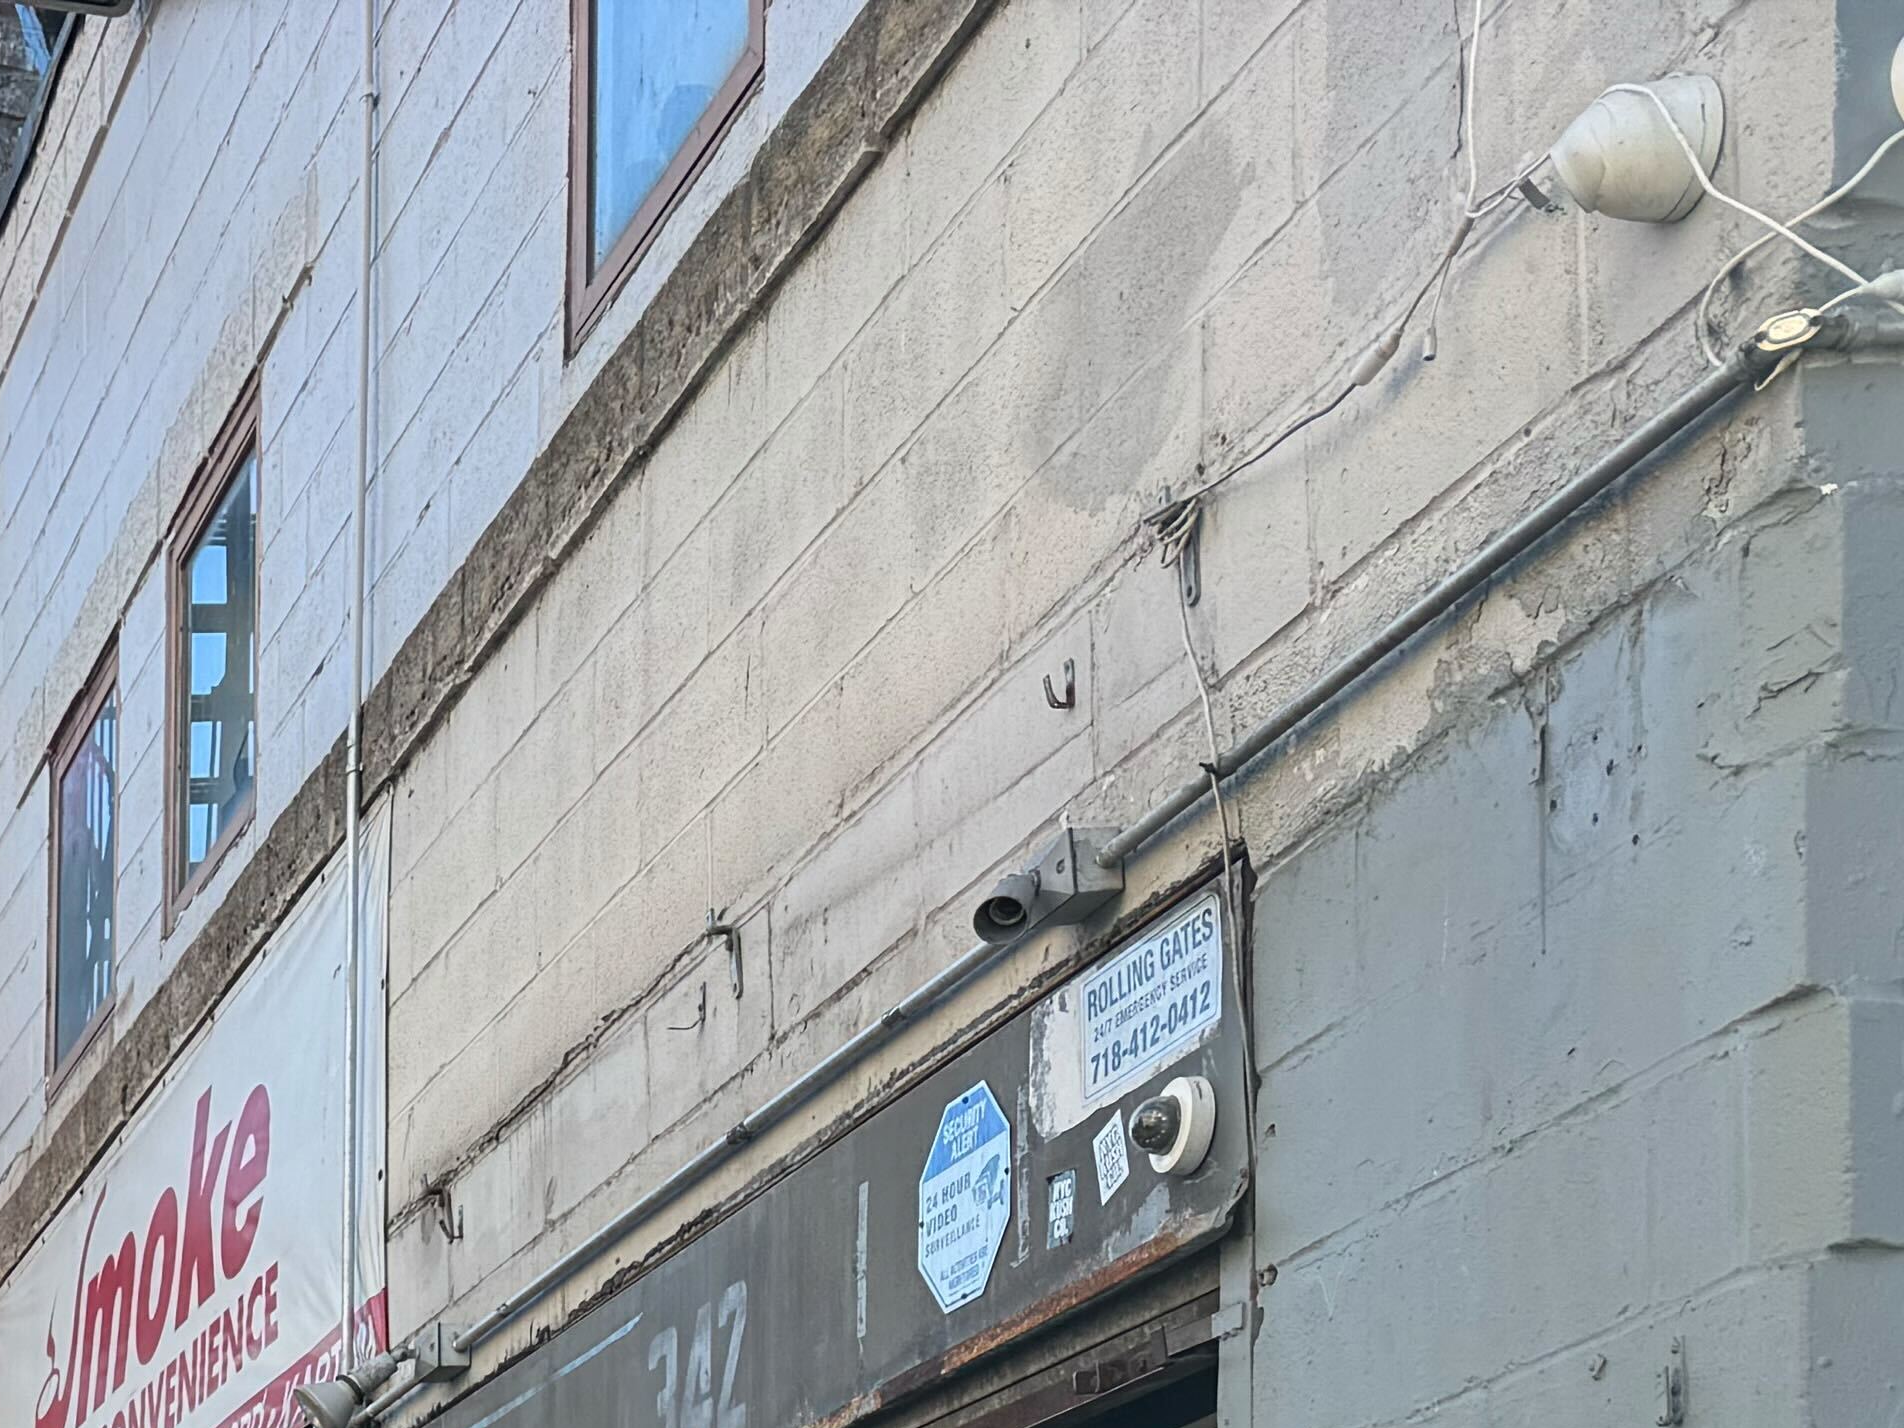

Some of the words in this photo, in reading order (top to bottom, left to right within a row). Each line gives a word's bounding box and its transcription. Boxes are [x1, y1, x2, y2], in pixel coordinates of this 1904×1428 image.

[1088, 948, 1155, 1022] ROLLING
[1159, 907, 1214, 971] GATES
[1115, 981, 1168, 1028] EMERGENCY
[1170, 952, 1208, 992] SERVICE
[1090, 979, 1211, 1084] 718-412-0412
[943, 1098, 986, 1144] SECURITY
[950, 1128, 980, 1161] ALERT
[925, 1193, 938, 1214] 24
[942, 1171, 972, 1202] HOUR
[926, 1206, 958, 1238] VIDEO
